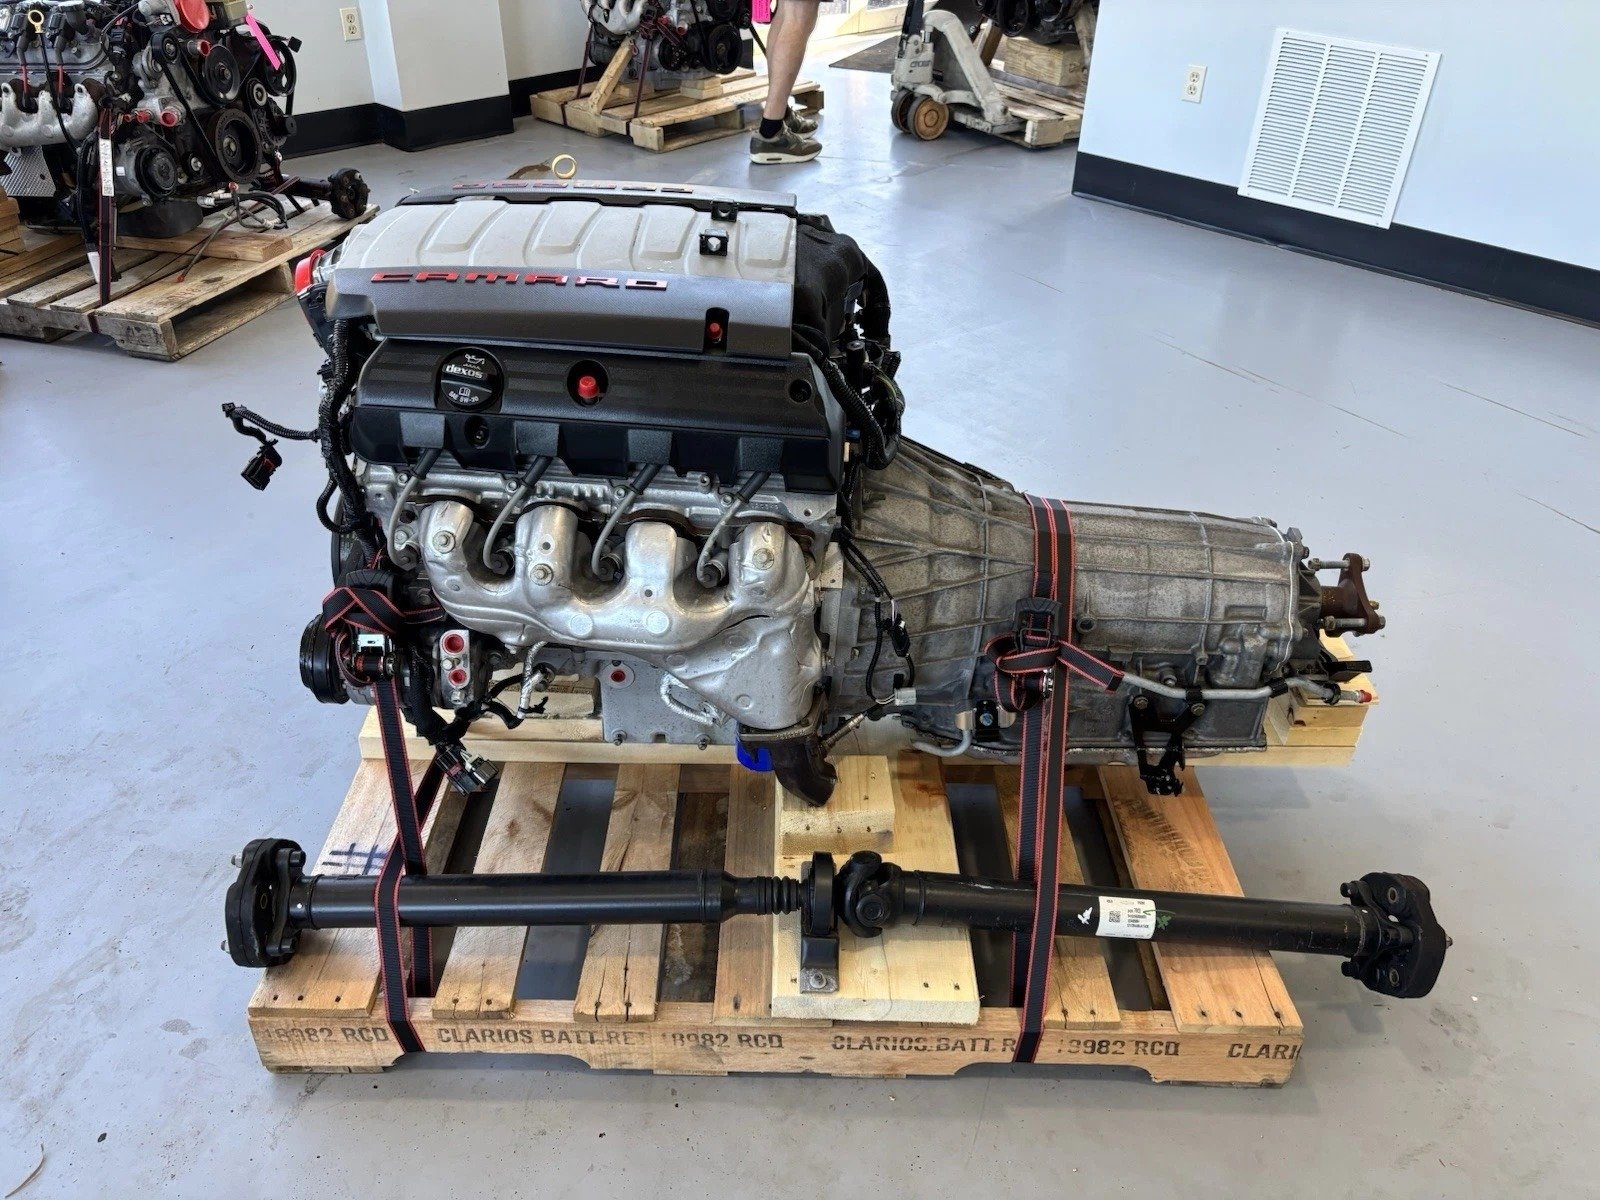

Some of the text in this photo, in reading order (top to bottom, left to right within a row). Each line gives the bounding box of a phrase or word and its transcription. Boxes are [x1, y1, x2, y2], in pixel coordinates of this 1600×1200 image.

[371, 272, 668, 291] CAMARO
[445, 364, 483, 379] dexos
[341, 1027, 390, 1043] RCD
[437, 1028, 534, 1044] CLARIOS
[737, 1033, 784, 1049] RCD
[1134, 1040, 1180, 1056] RCD
[1227, 1043, 1303, 1060] CLARI
